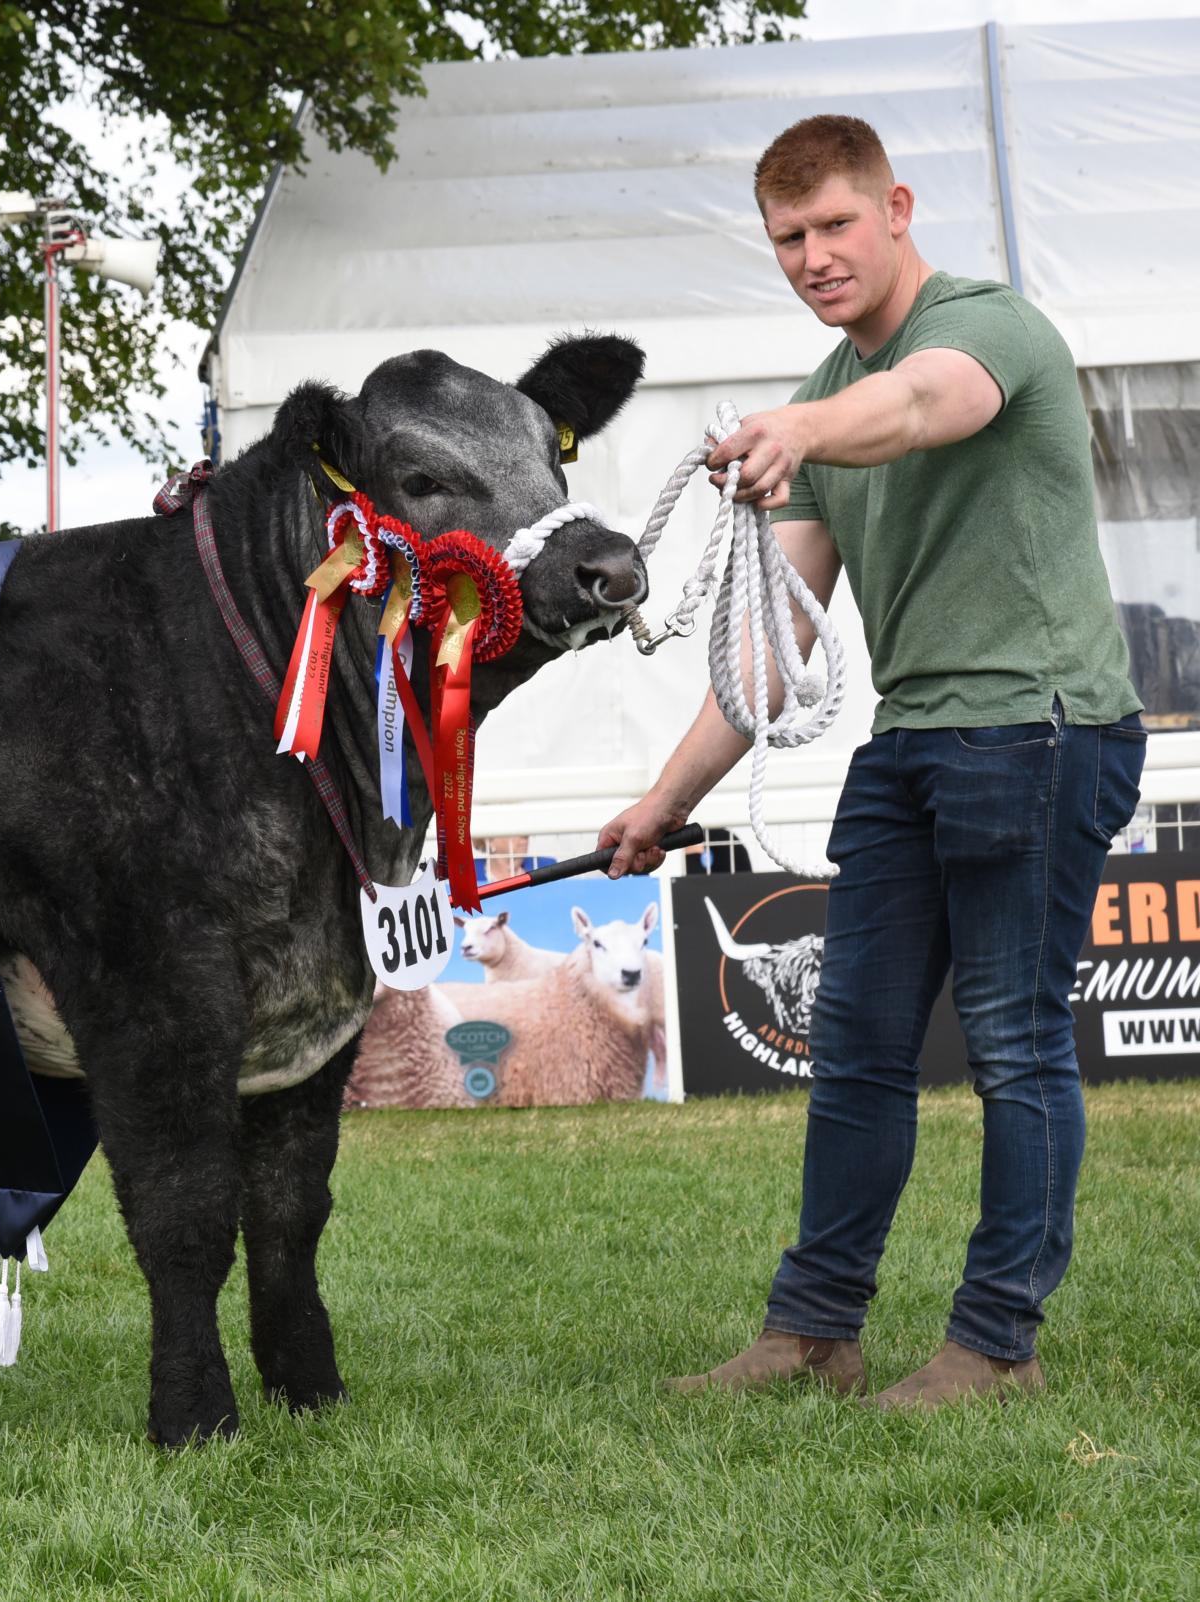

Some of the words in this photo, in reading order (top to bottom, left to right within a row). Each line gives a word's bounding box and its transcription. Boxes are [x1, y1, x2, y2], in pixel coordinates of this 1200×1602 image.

[323, 606, 341, 638] Royal
[308, 650, 319, 679] 2022
[318, 642, 333, 694] Highland
[455, 728, 466, 759] Royal
[443, 771, 453, 799] 2022
[455, 762, 466, 812] Highland
[457, 815, 467, 845] Show
[378, 888, 447, 973] 3101
[450, 1031, 506, 1044] SCOTCH
